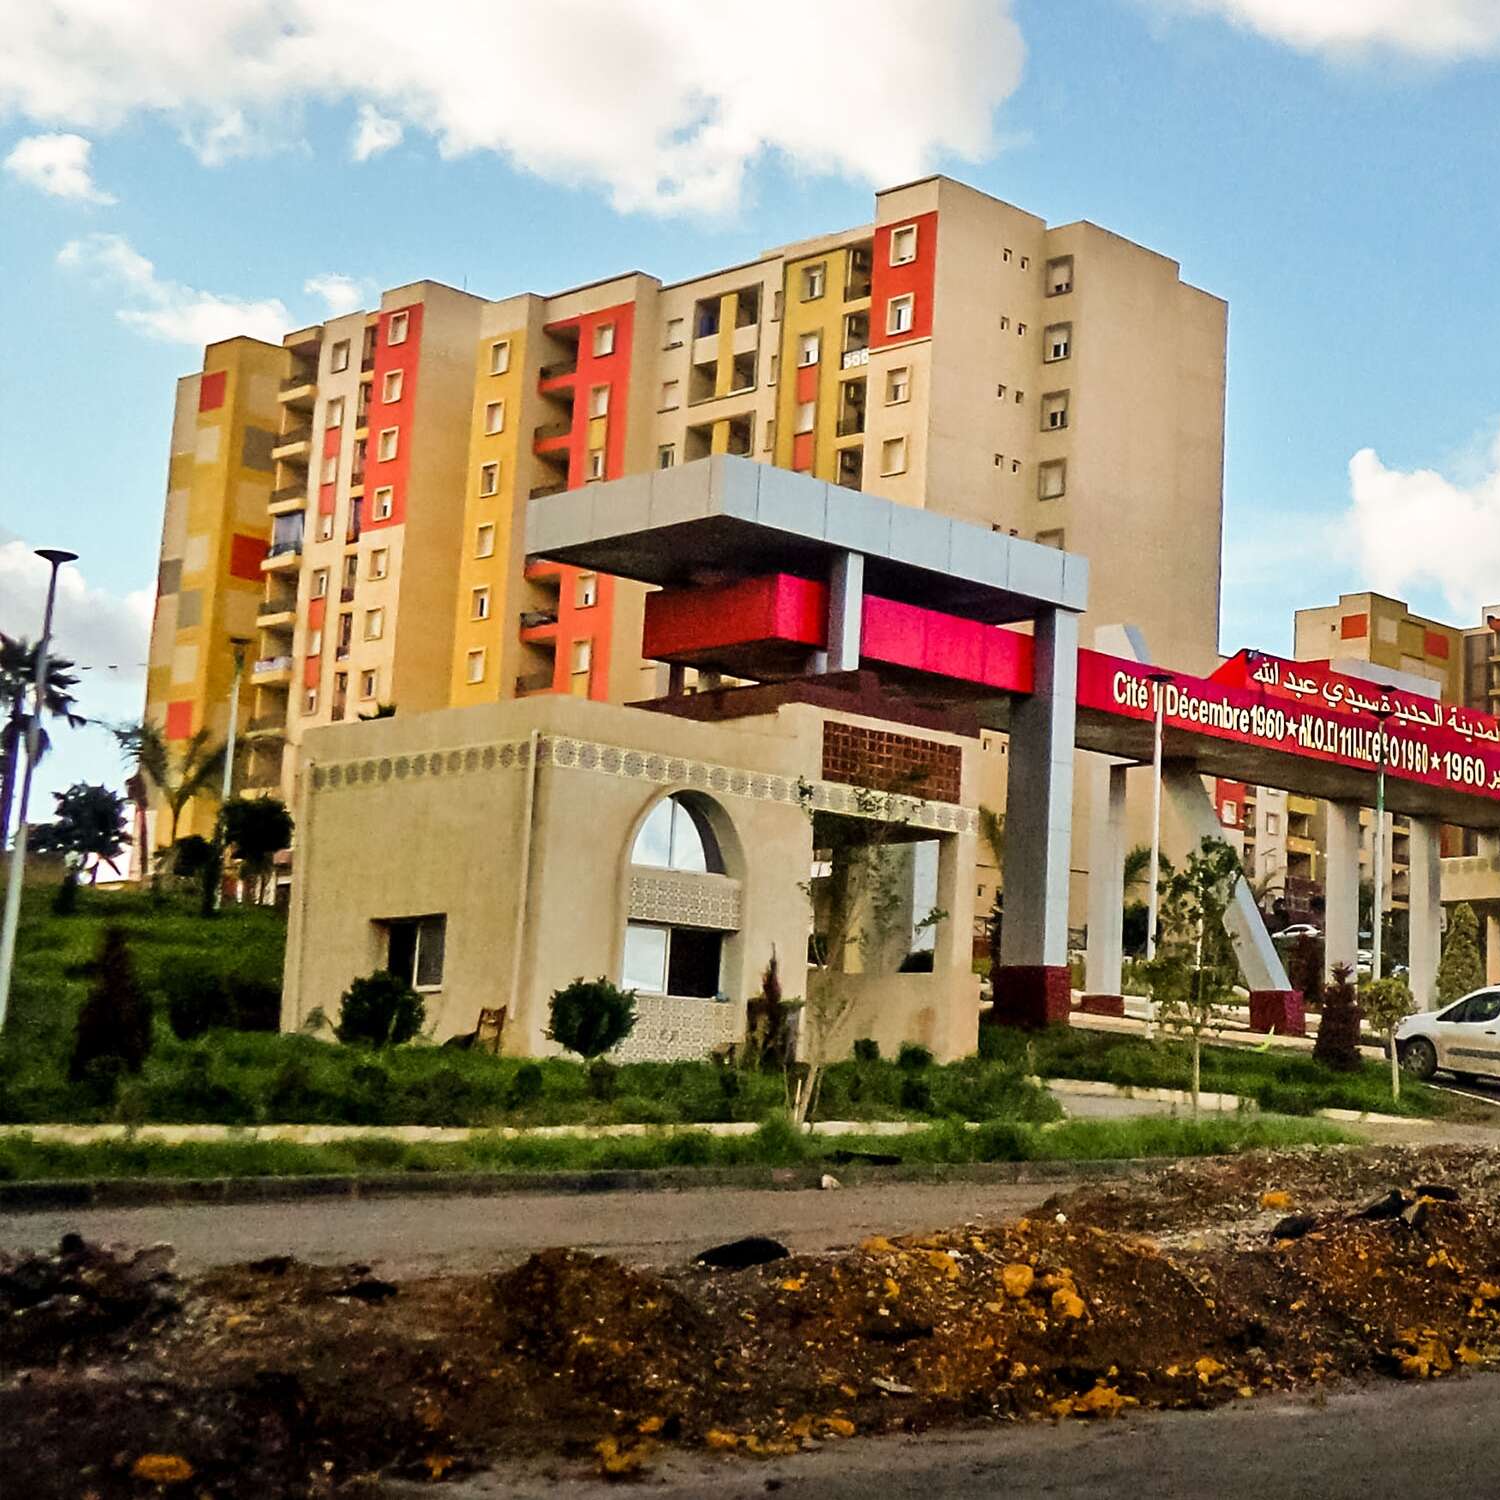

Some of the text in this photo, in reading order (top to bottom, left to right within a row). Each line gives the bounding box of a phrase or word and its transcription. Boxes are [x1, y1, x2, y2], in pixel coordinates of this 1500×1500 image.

[1253, 657, 1278, 684] الله
[1283, 671, 1318, 698] عبد
[1113, 671, 1148, 709] Cité
[1166, 684, 1249, 733] Décembre
[1250, 704, 1285, 741] 1960
[1322, 682, 1379, 713] سيدي
[1382, 695, 1442, 731] الجديدة
[1401, 738, 1428, 774] 1960
[1443, 751, 1485, 787] 1960
